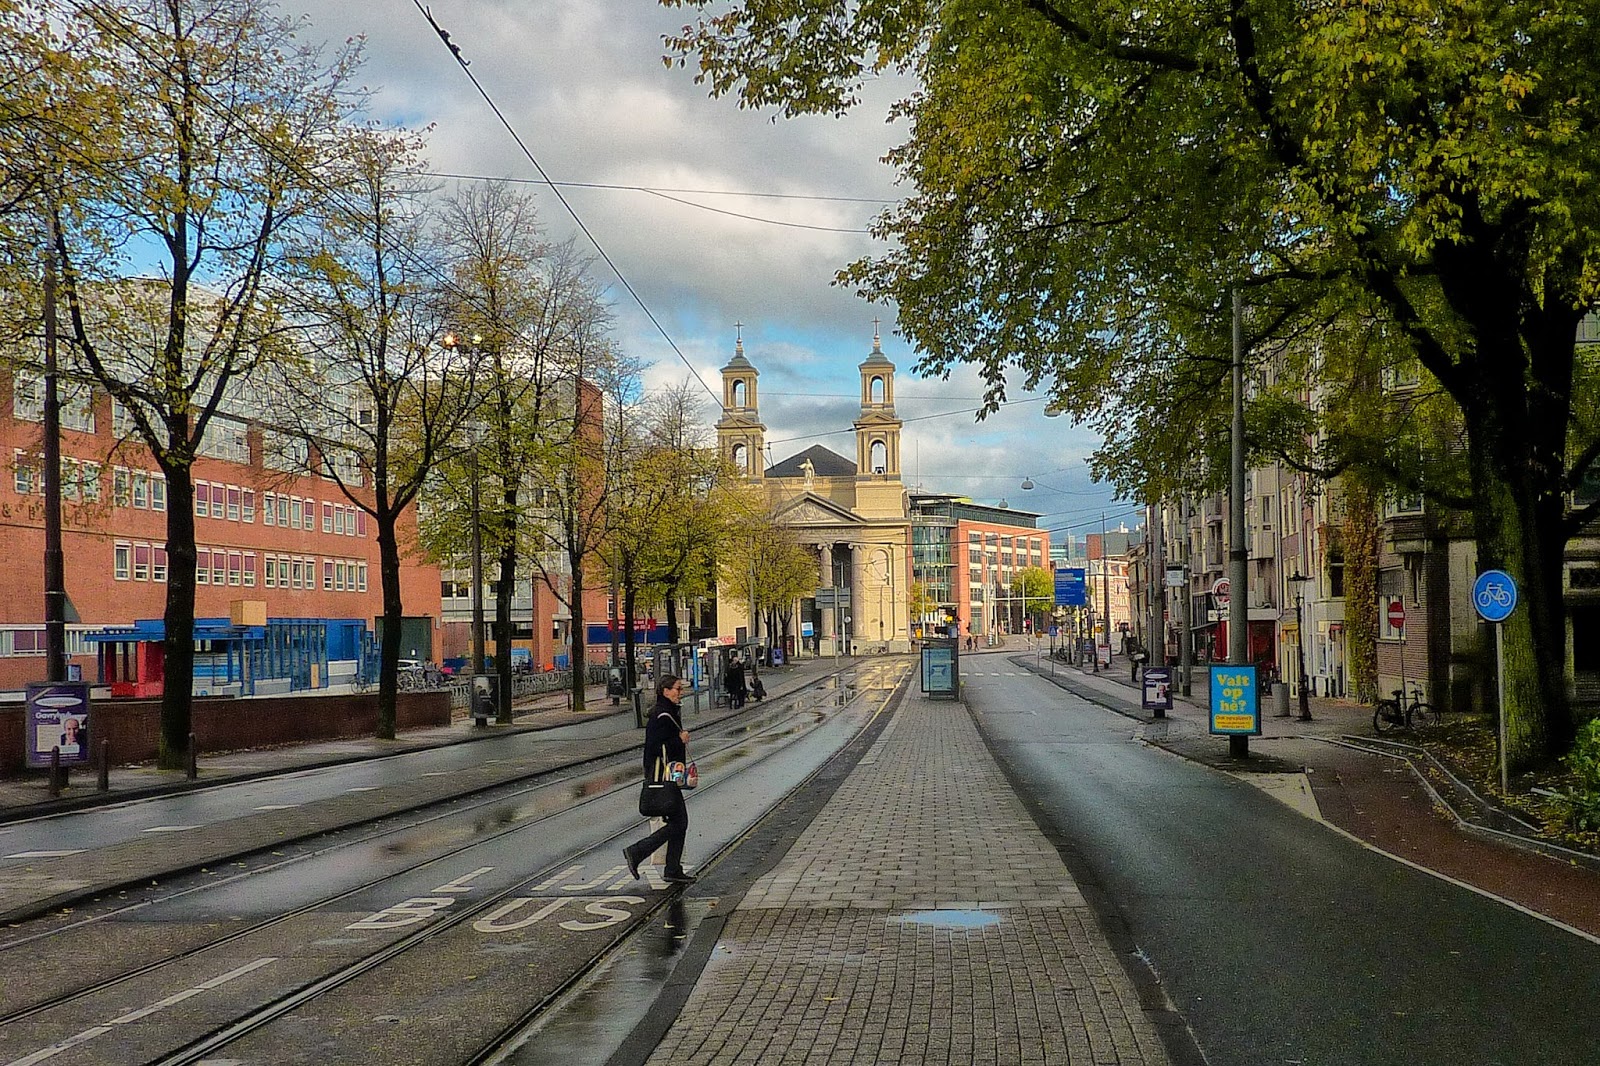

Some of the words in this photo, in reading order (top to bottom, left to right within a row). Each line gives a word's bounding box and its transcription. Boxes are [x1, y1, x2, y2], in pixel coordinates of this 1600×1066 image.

[29, 505, 92, 527] BLET
[1217, 674, 1249, 686] Valt
[1223, 688, 1243, 700] op
[345, 896, 646, 933] BUS
